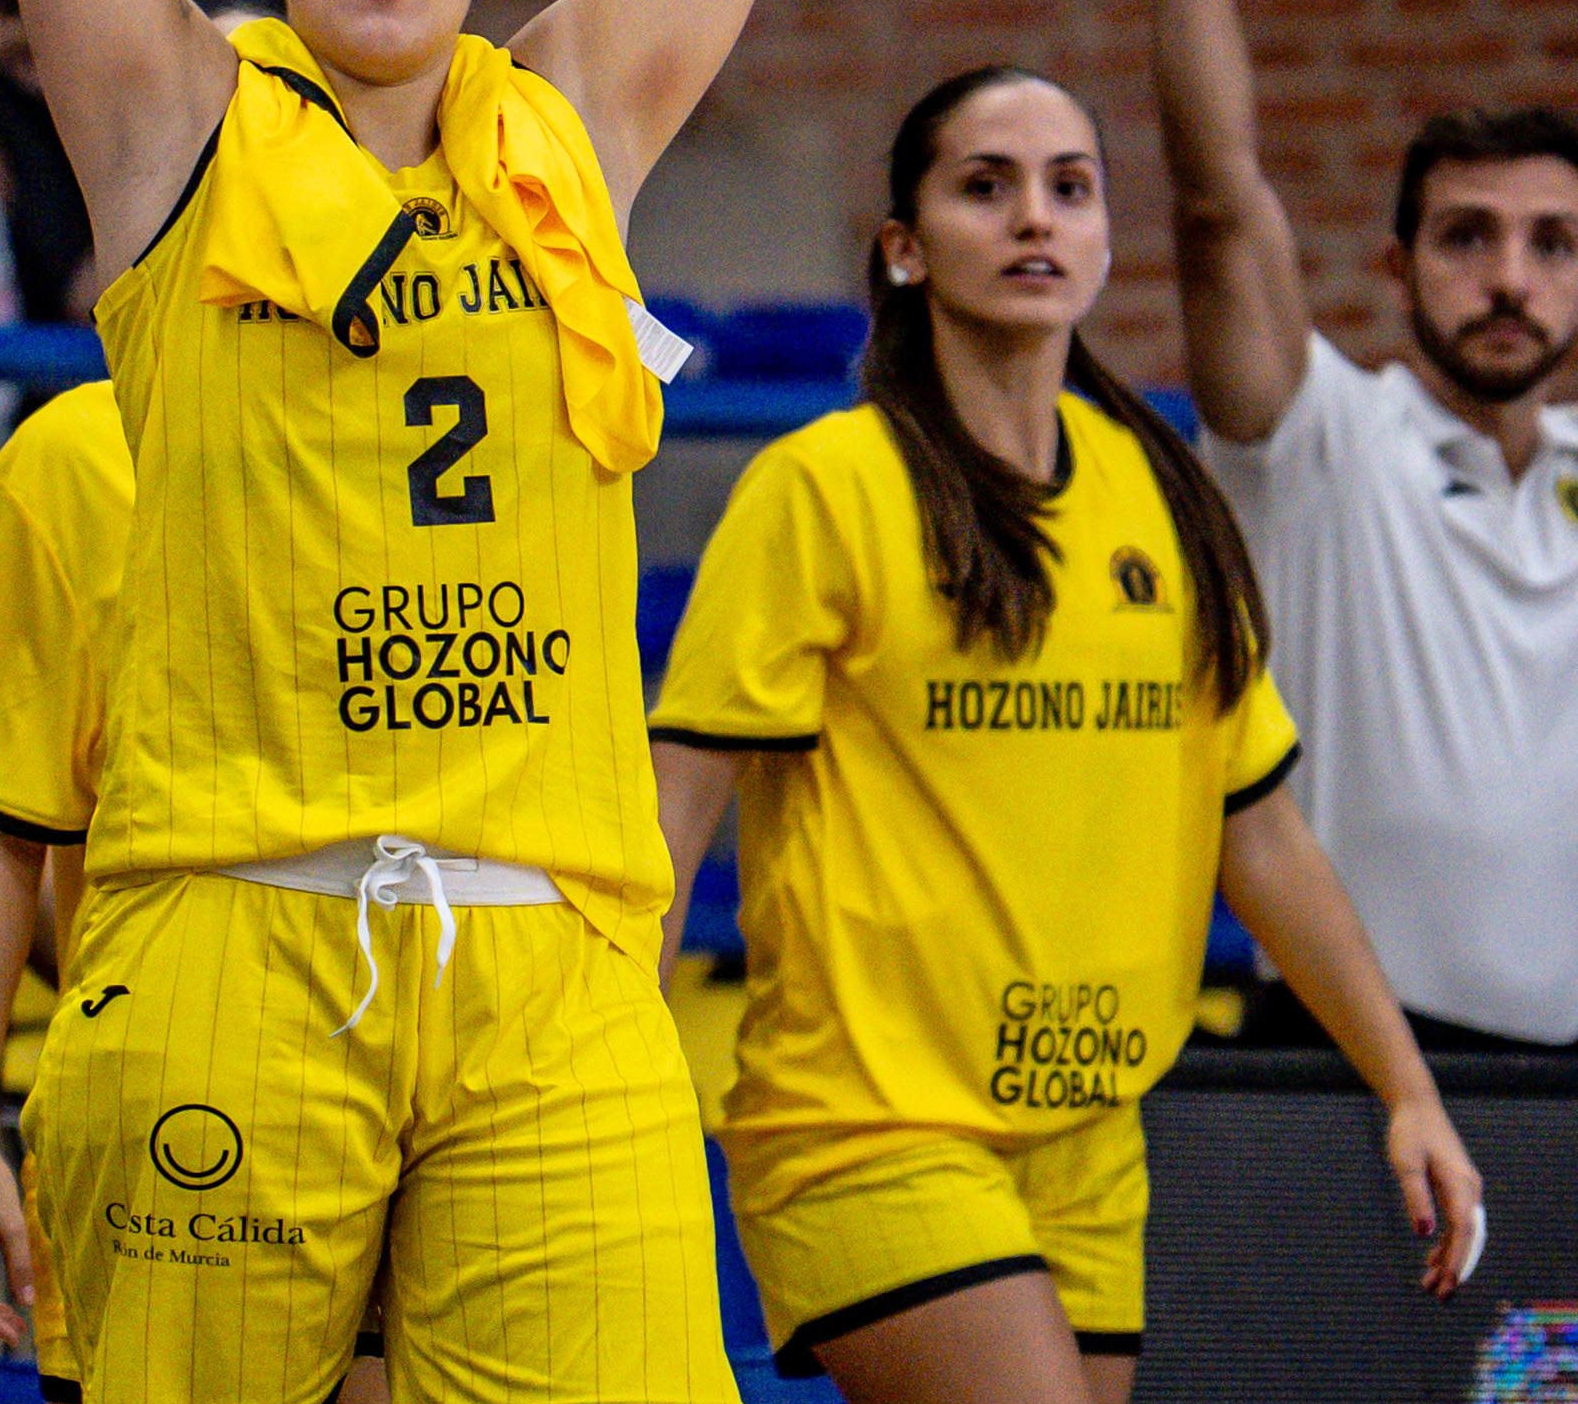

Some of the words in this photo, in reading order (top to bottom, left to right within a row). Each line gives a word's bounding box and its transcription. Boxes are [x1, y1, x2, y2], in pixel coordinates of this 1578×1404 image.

[403, 375, 495, 528] 2
[334, 580, 525, 633] GRUPO
[337, 629, 570, 682] HOZONO
[339, 680, 550, 732] GLOBAL
[925, 680, 1085, 730] HOZONO
[1002, 981, 1119, 1024] GRUPO
[996, 1023, 1147, 1067] HOZONO
[990, 1065, 1119, 1108] GLOBAL
[105, 1203, 176, 1238] Csta
[189, 1214, 306, 1245] Cálida
[144, 1246, 164, 1261] de
[170, 1249, 231, 1267] Murcia
